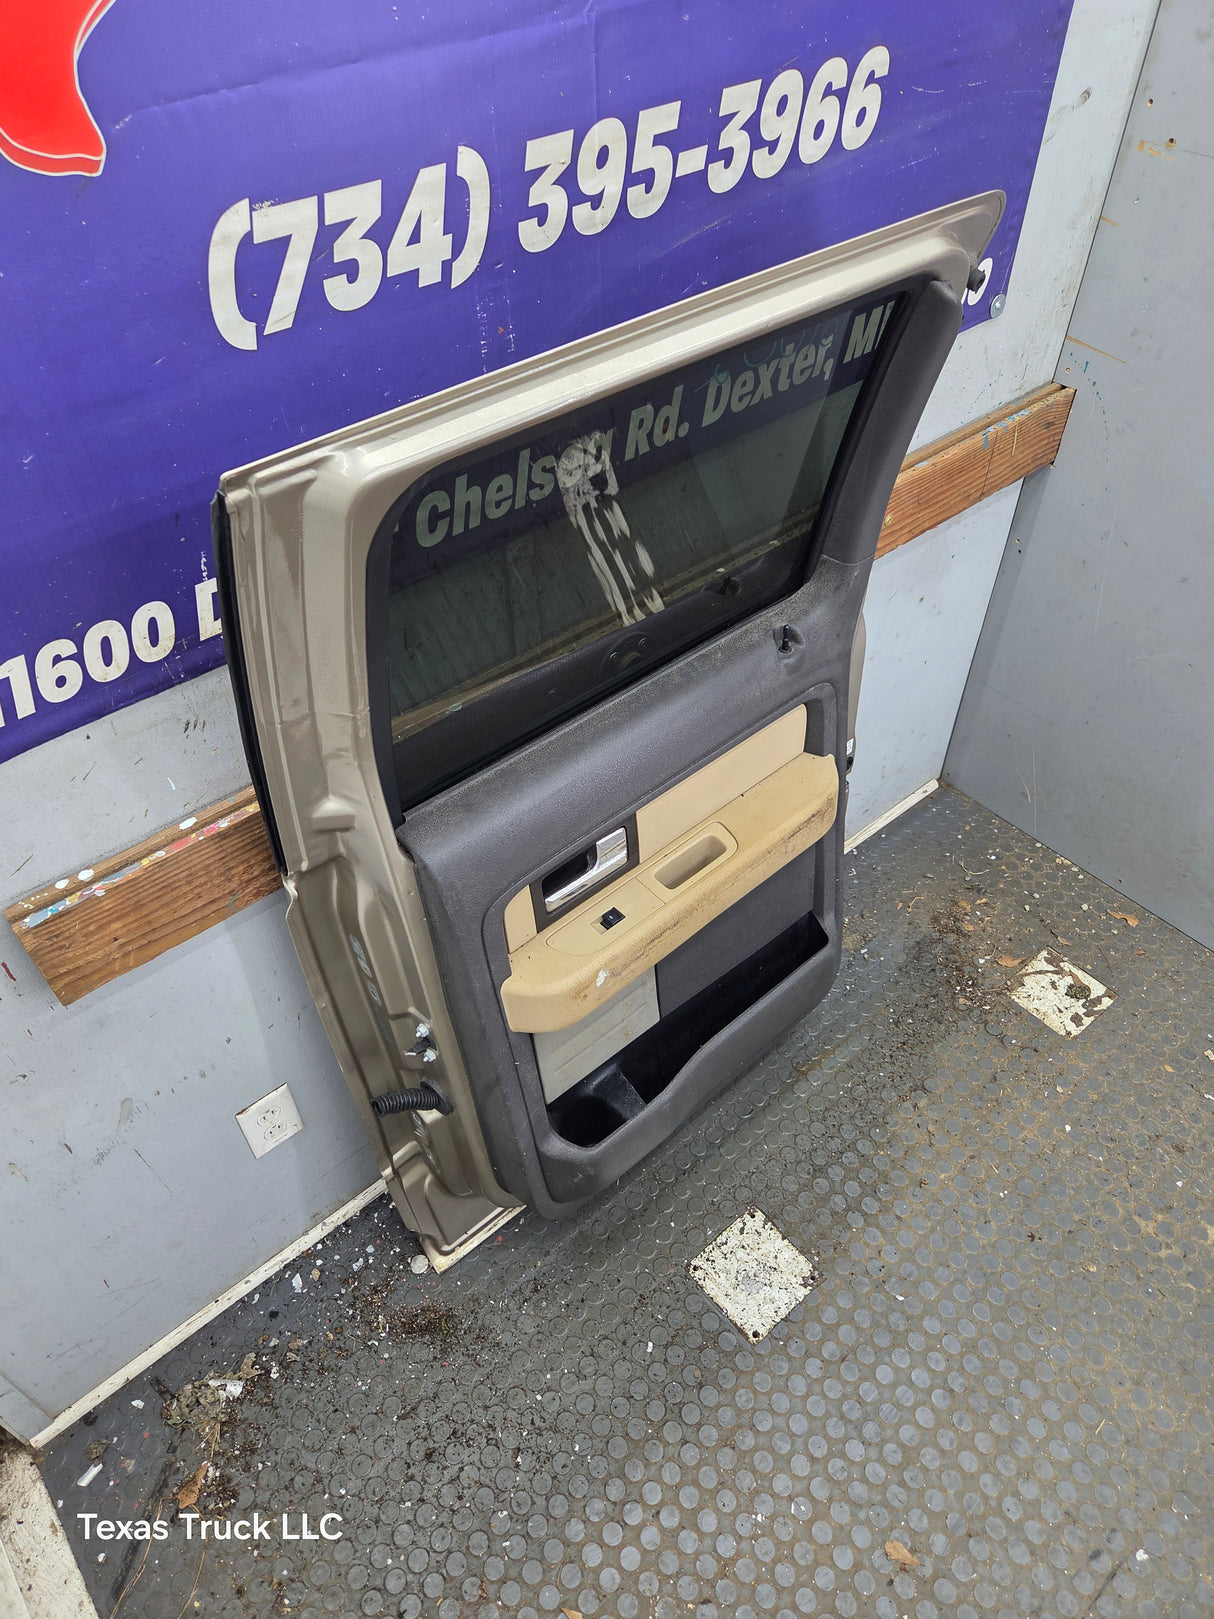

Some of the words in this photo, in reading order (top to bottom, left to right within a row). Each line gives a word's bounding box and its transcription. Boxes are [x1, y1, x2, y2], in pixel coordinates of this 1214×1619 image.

[208, 145, 491, 350] (734)
[518, 45, 890, 253] 395-3966
[0, 600, 176, 728] 1600
[625, 384, 690, 462] Rd.
[701, 333, 835, 427] Dexter,
